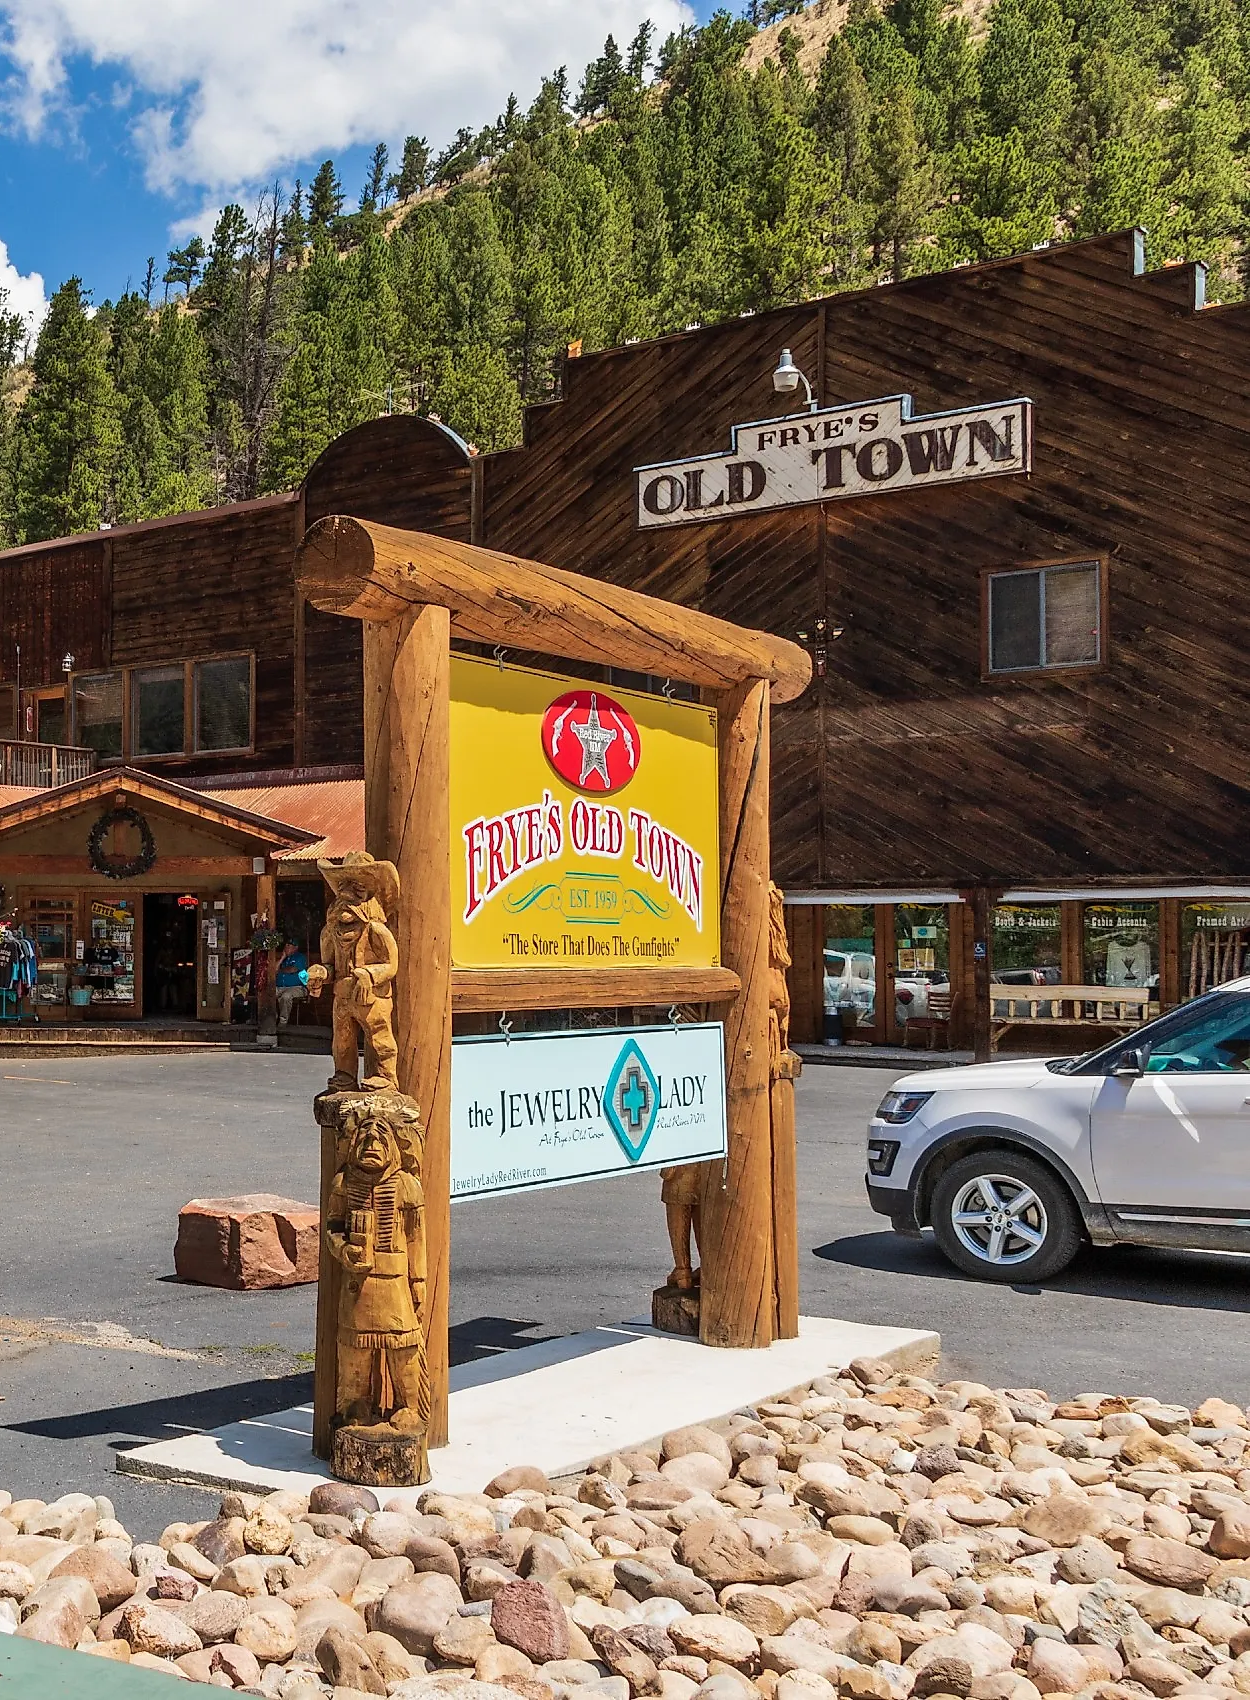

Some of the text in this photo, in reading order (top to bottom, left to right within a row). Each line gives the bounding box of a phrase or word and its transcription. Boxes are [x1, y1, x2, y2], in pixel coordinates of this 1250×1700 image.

[756, 411, 879, 451] FRYE'S
[642, 414, 1016, 516] OLD TOWN
[579, 728, 612, 743] Red River
[590, 741, 601, 752] NM
[463, 791, 703, 926] FRYE'S OLD TOWN
[569, 888, 617, 909] EST. 1959
[995, 916, 1056, 927] Boots & Jackets
[1091, 916, 1147, 927] Cabin Accents
[1196, 915, 1245, 927] Framed Art
[532, 936, 559, 956] Store
[561, 934, 585, 956] That
[587, 936, 610, 957] Does
[612, 936, 630, 957] The
[468, 1075, 708, 1138] the JEWELRY LADY
[657, 1116, 671, 1129] Red
[672, 1114, 690, 1127] River
[539, 1126, 605, 1148] At Frye's Old Town
[452, 1167, 547, 1192] JewelryLadyRedRiver.com
